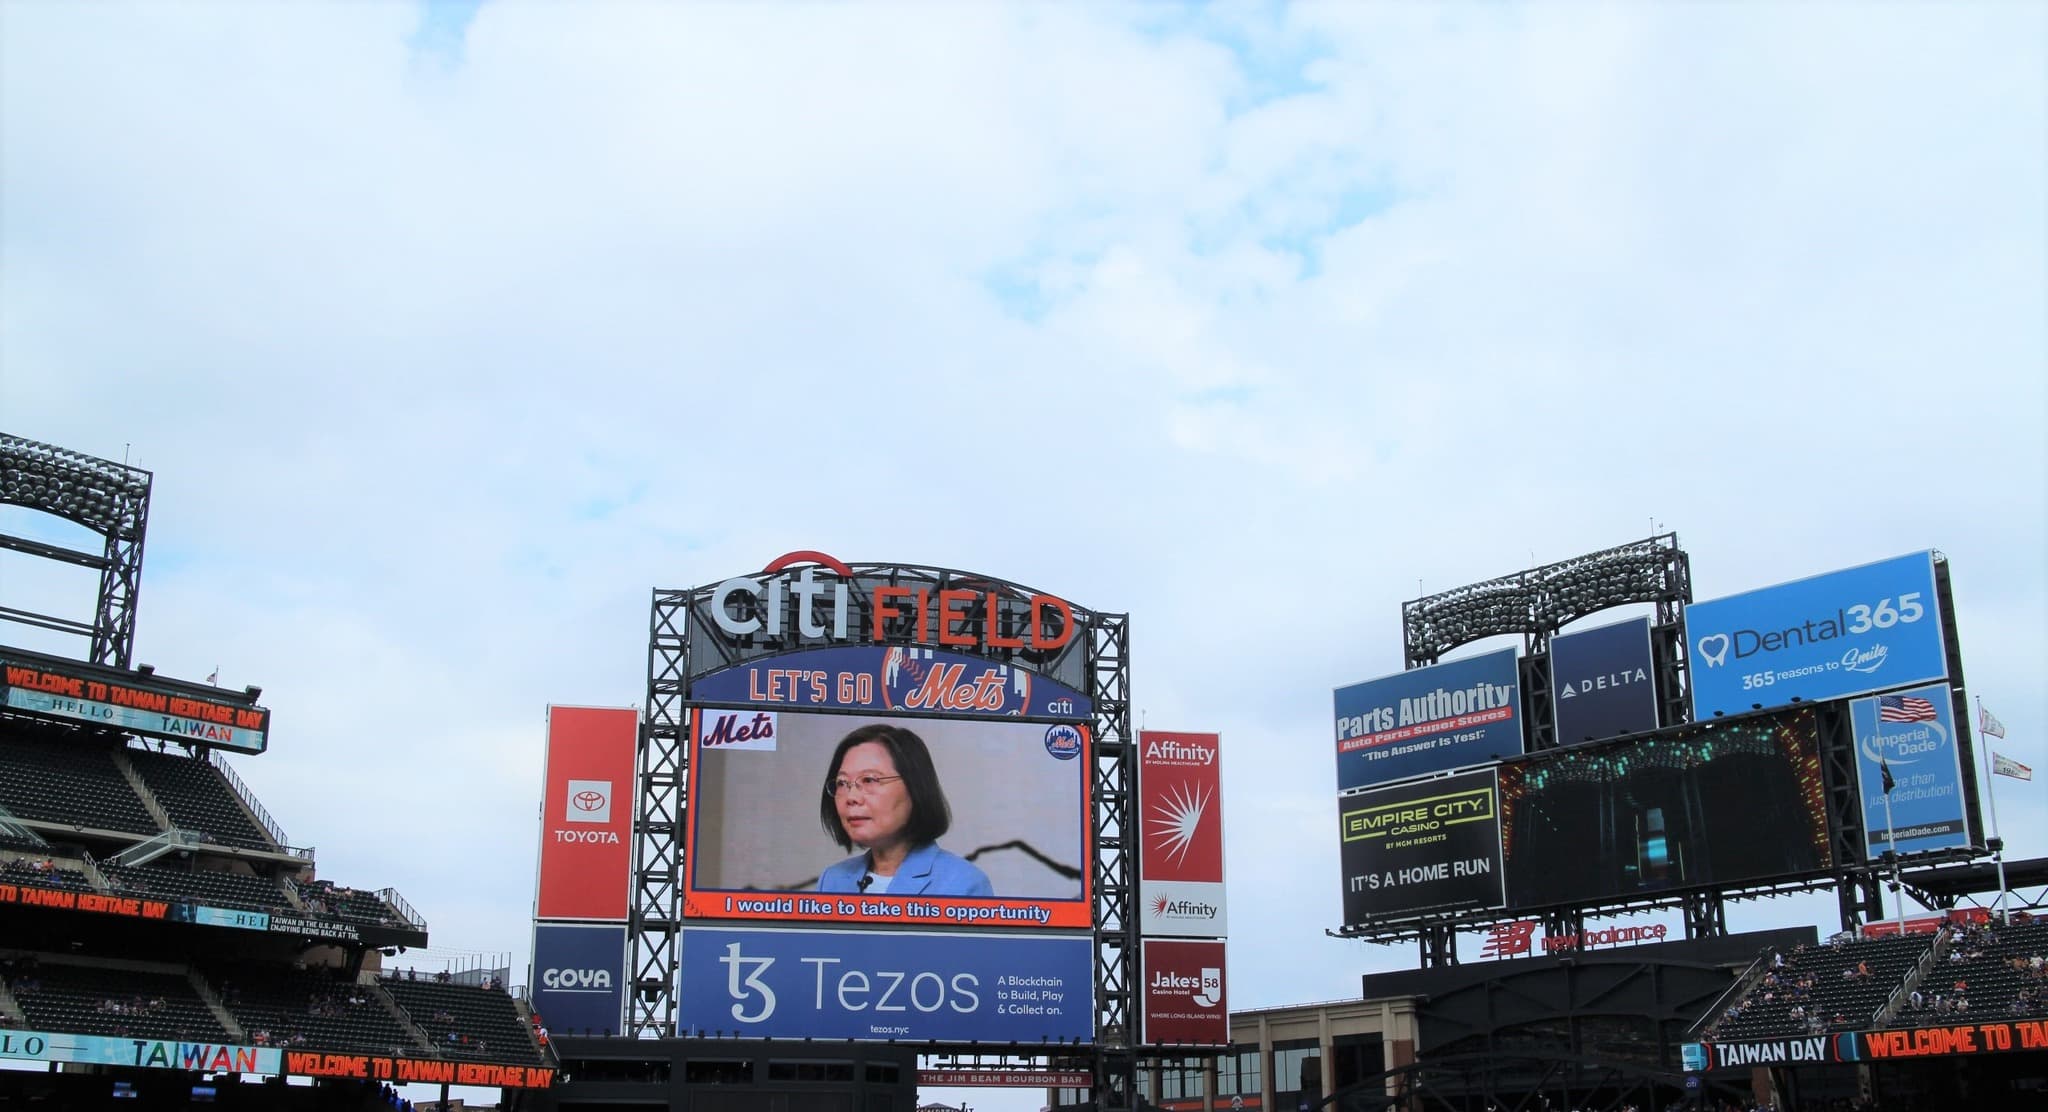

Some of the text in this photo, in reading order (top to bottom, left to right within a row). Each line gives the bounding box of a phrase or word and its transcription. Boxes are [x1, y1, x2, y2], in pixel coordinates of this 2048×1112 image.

[873, 585, 1074, 649] FIELD
[1742, 643, 1888, 690] 365 reasons to Smile
[749, 662, 1005, 711] LET'S GO Mets
[1581, 668, 1647, 693] DELTA
[7, 666, 263, 730] WELCOME TO TAIWAN HERITAGE DAY
[1048, 699, 1073, 715] citi
[52, 699, 114, 719] HELLO
[1337, 683, 1510, 741] Parts Authority
[162, 716, 232, 741] TAIWAN
[702, 713, 776, 747] Mets
[1343, 711, 1507, 750] Auto Parts Super Stores
[1871, 727, 1930, 749] Imperial
[1145, 741, 1215, 766] Affinity
[1391, 739, 1437, 757] Answer
[1439, 736, 1450, 747] Is
[1898, 740, 1937, 756] Dade
[1911, 773, 1936, 786] than
[1892, 782, 1954, 803] distribution!
[1350, 798, 1482, 832] EMPIRE CITY
[555, 830, 619, 844] TOYOTA
[1391, 821, 1440, 836] CASINO
[1413, 834, 1447, 845] RESORTS
[1351, 857, 1490, 892] IT'S A HOME RUN
[0, 885, 168, 918] TO TAIWAN HERITAGE DAY
[726, 897, 1050, 926] I would like to take this opportunity
[1167, 901, 1217, 919] Affinity
[271, 917, 297, 926] TAIWAN
[298, 919, 305, 927] IN
[306, 920, 318, 928] THE
[332, 923, 343, 931] ARE
[271, 924, 301, 934] ENJOYING
[337, 931, 346, 939] AT
[347, 932, 360, 940] THE
[543, 968, 611, 989] GOYA
[801, 957, 979, 1012] Tezos
[997, 976, 1063, 988] A Blockchain
[1151, 971, 1219, 988] Jake's 58
[997, 990, 1064, 1004] to Build, Play
[1152, 988, 1190, 997] Casino Hotel
[997, 1004, 1063, 1016] & Collect on.
[871, 1024, 909, 1036] tezos.nyc
[1866, 1026, 1977, 1058] WELCOME
[1980, 1023, 2011, 1050] TO
[133, 1041, 257, 1073] TAIWAN
[1716, 1036, 1827, 1067] TAIWAN DAY
[288, 1052, 553, 1089] WELCOME TO TAIWAN HERITAGE DAY
[922, 1074, 1082, 1085] THE JIM BEAM BOURBON BAR
